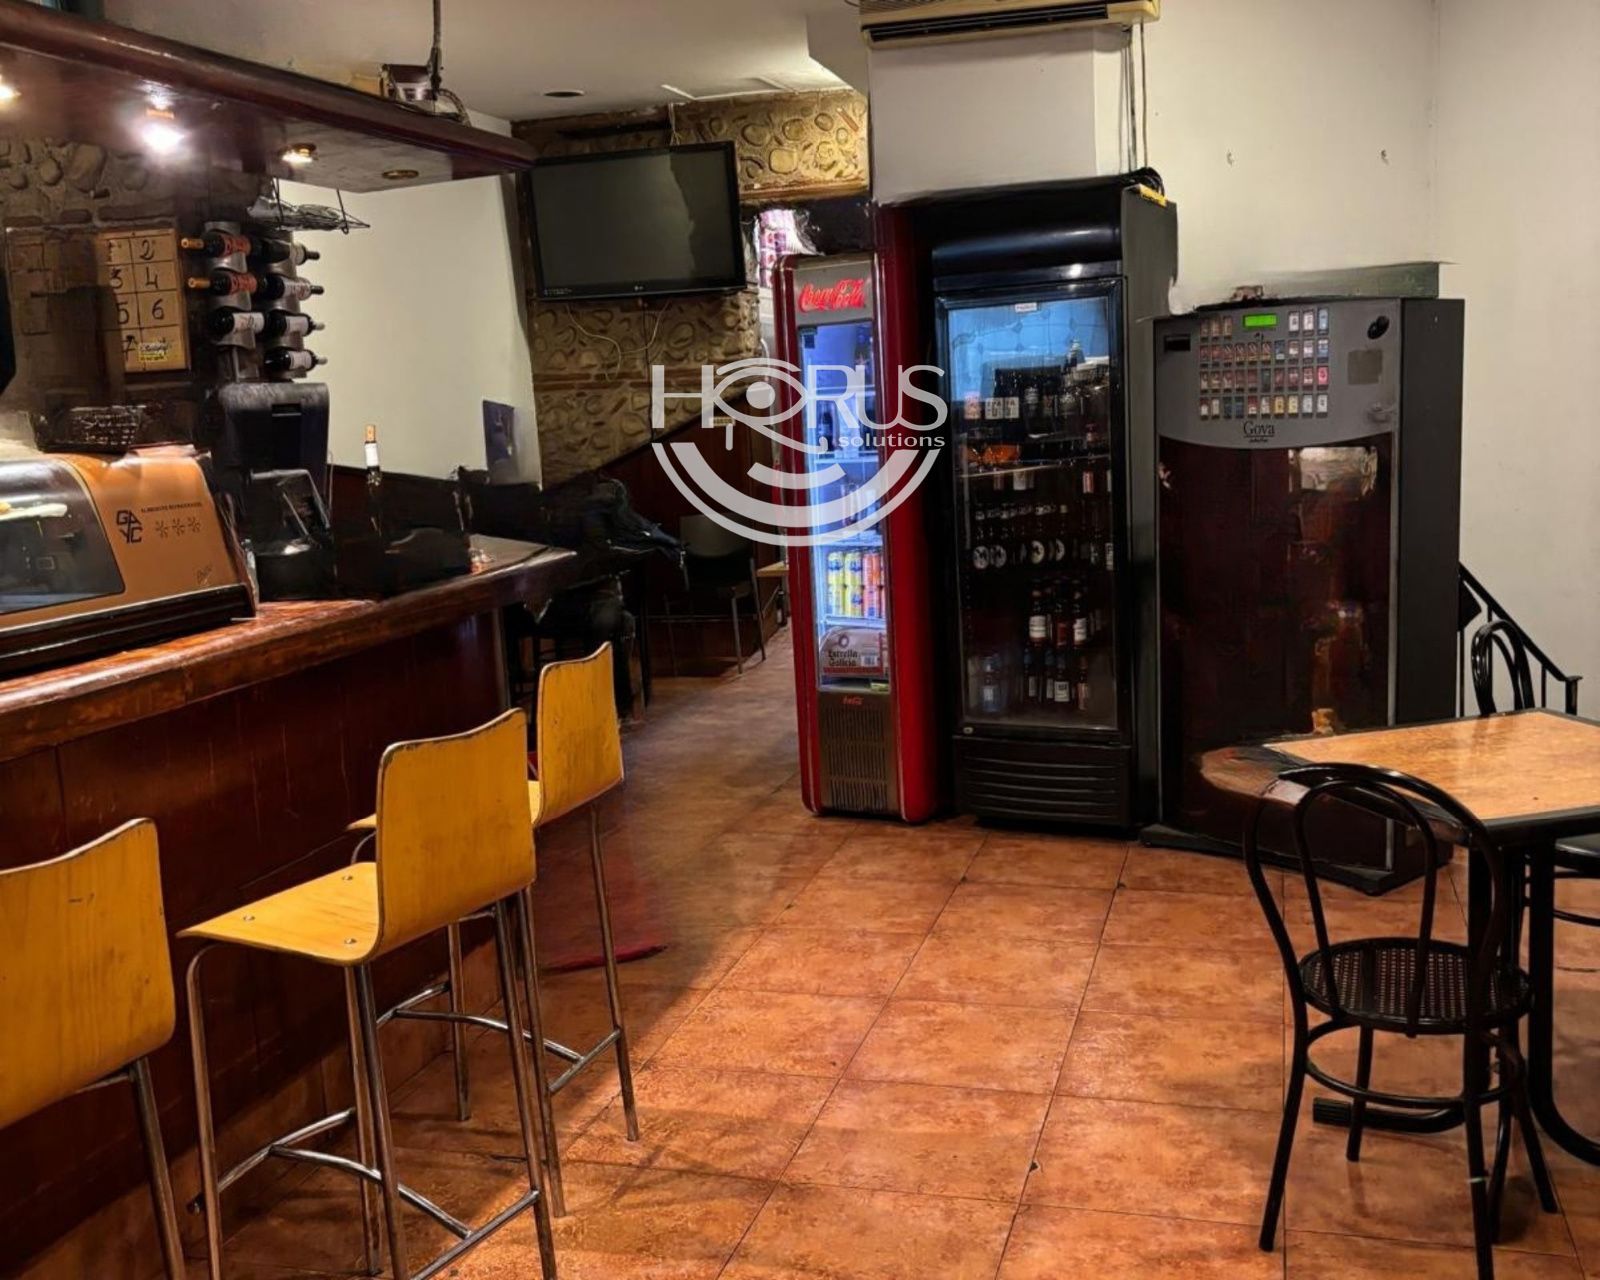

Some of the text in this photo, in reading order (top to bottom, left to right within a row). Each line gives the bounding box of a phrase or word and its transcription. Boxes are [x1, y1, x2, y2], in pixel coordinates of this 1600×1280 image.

[139, 240, 155, 260] 2
[110, 267, 123, 289] 3
[145, 266, 158, 289] 4
[116, 301, 129, 325] 5
[151, 298, 164, 320] 6
